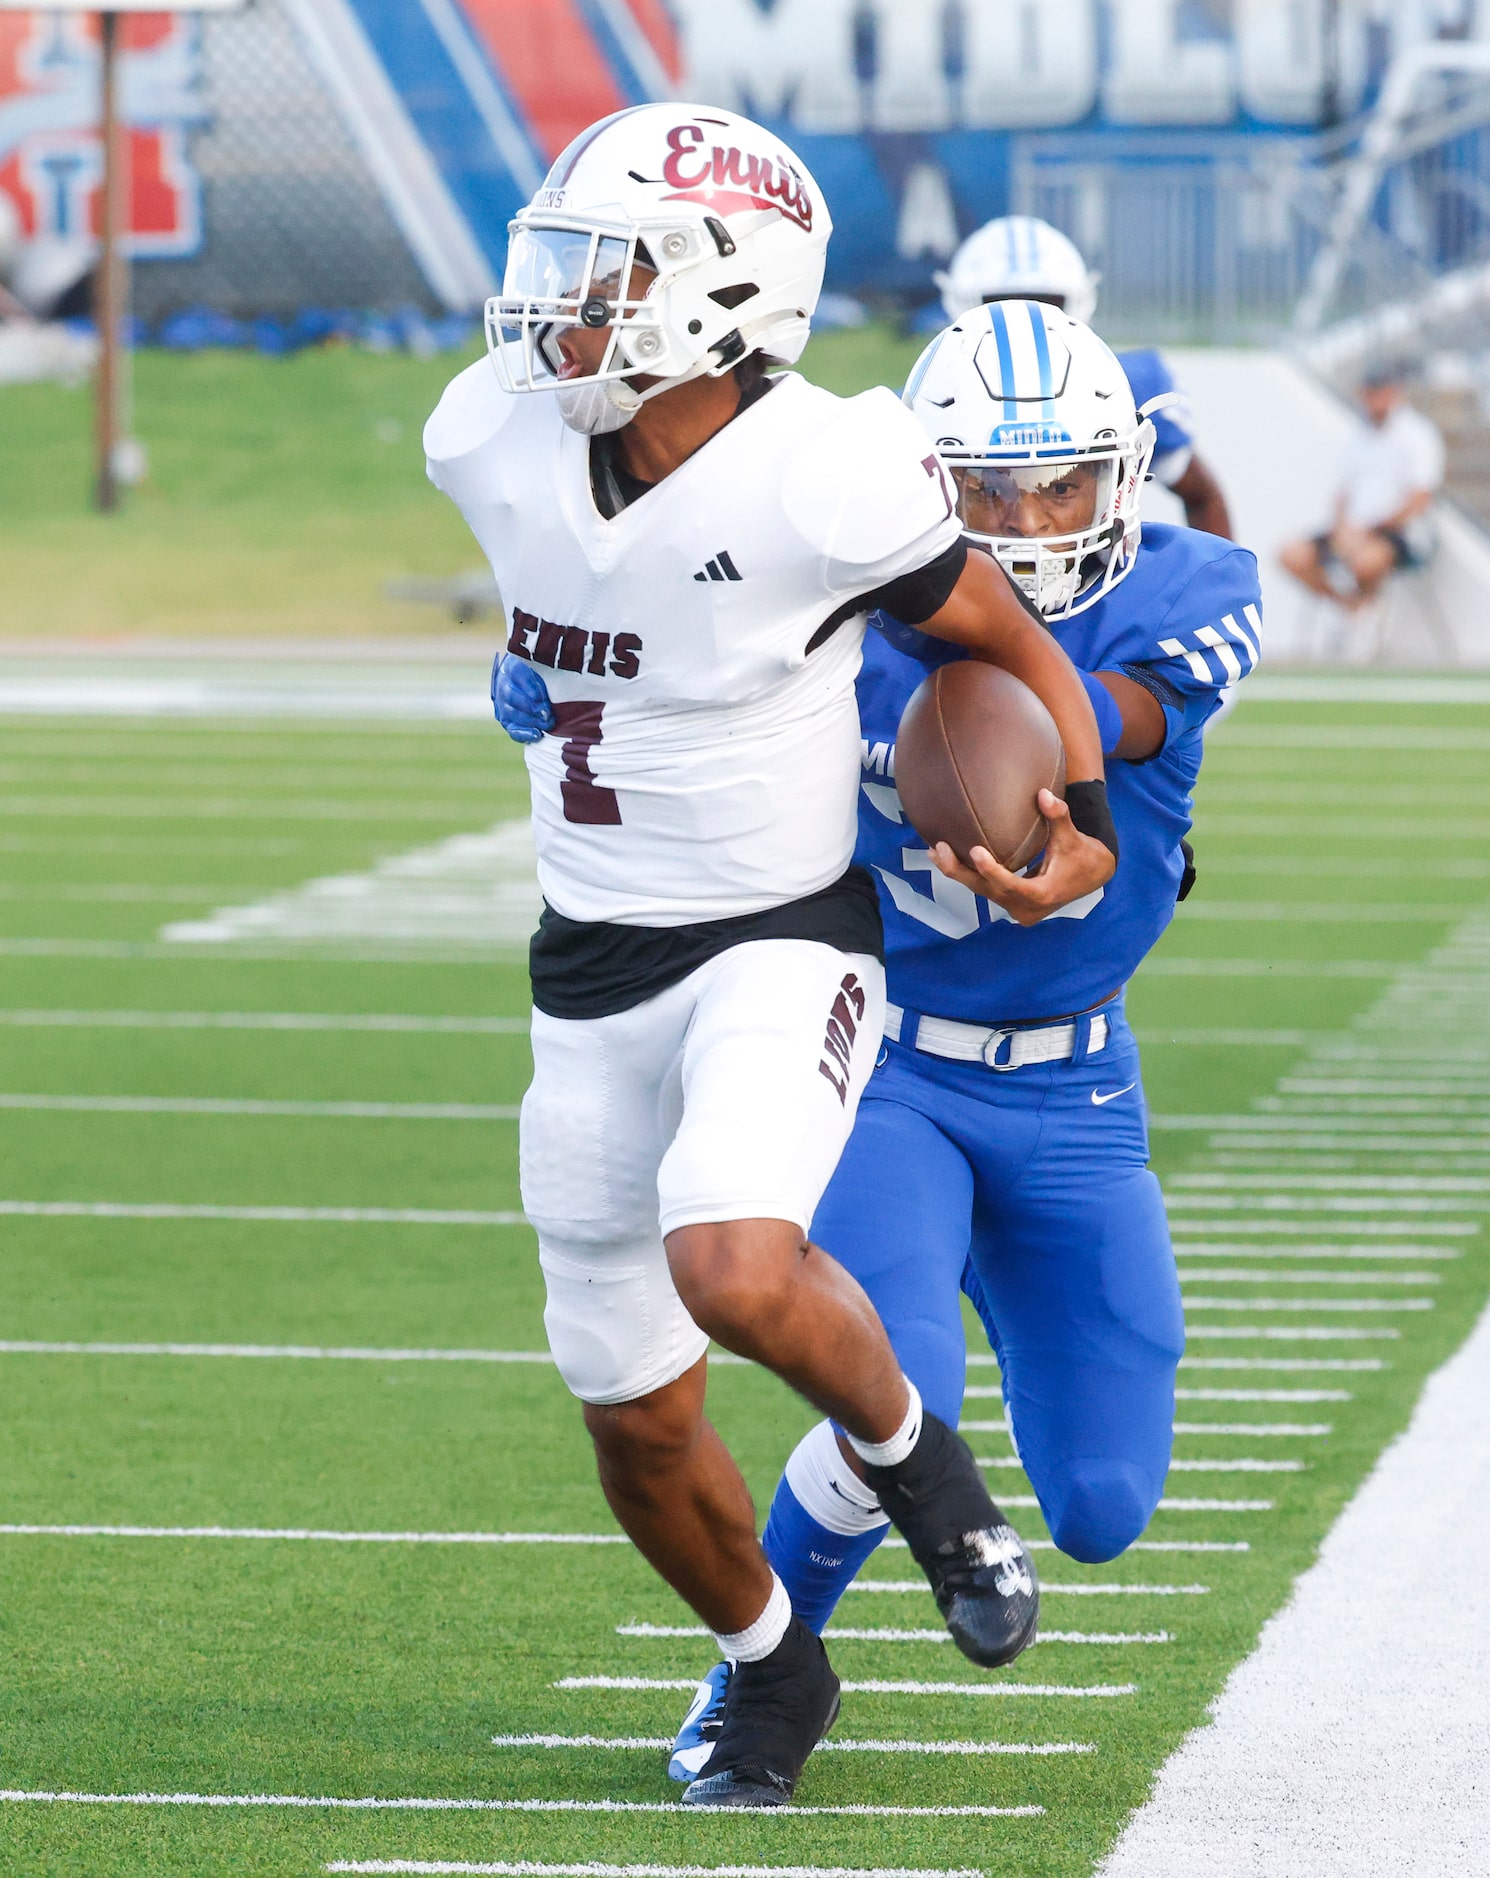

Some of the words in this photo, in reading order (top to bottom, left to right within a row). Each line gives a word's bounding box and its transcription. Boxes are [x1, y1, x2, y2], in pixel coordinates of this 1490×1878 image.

[662, 125, 813, 222] Ennis
[920, 453, 953, 521] 7
[507, 606, 643, 680] ENNIS
[547, 700, 623, 826] 7
[818, 973, 866, 1110] LIONS
